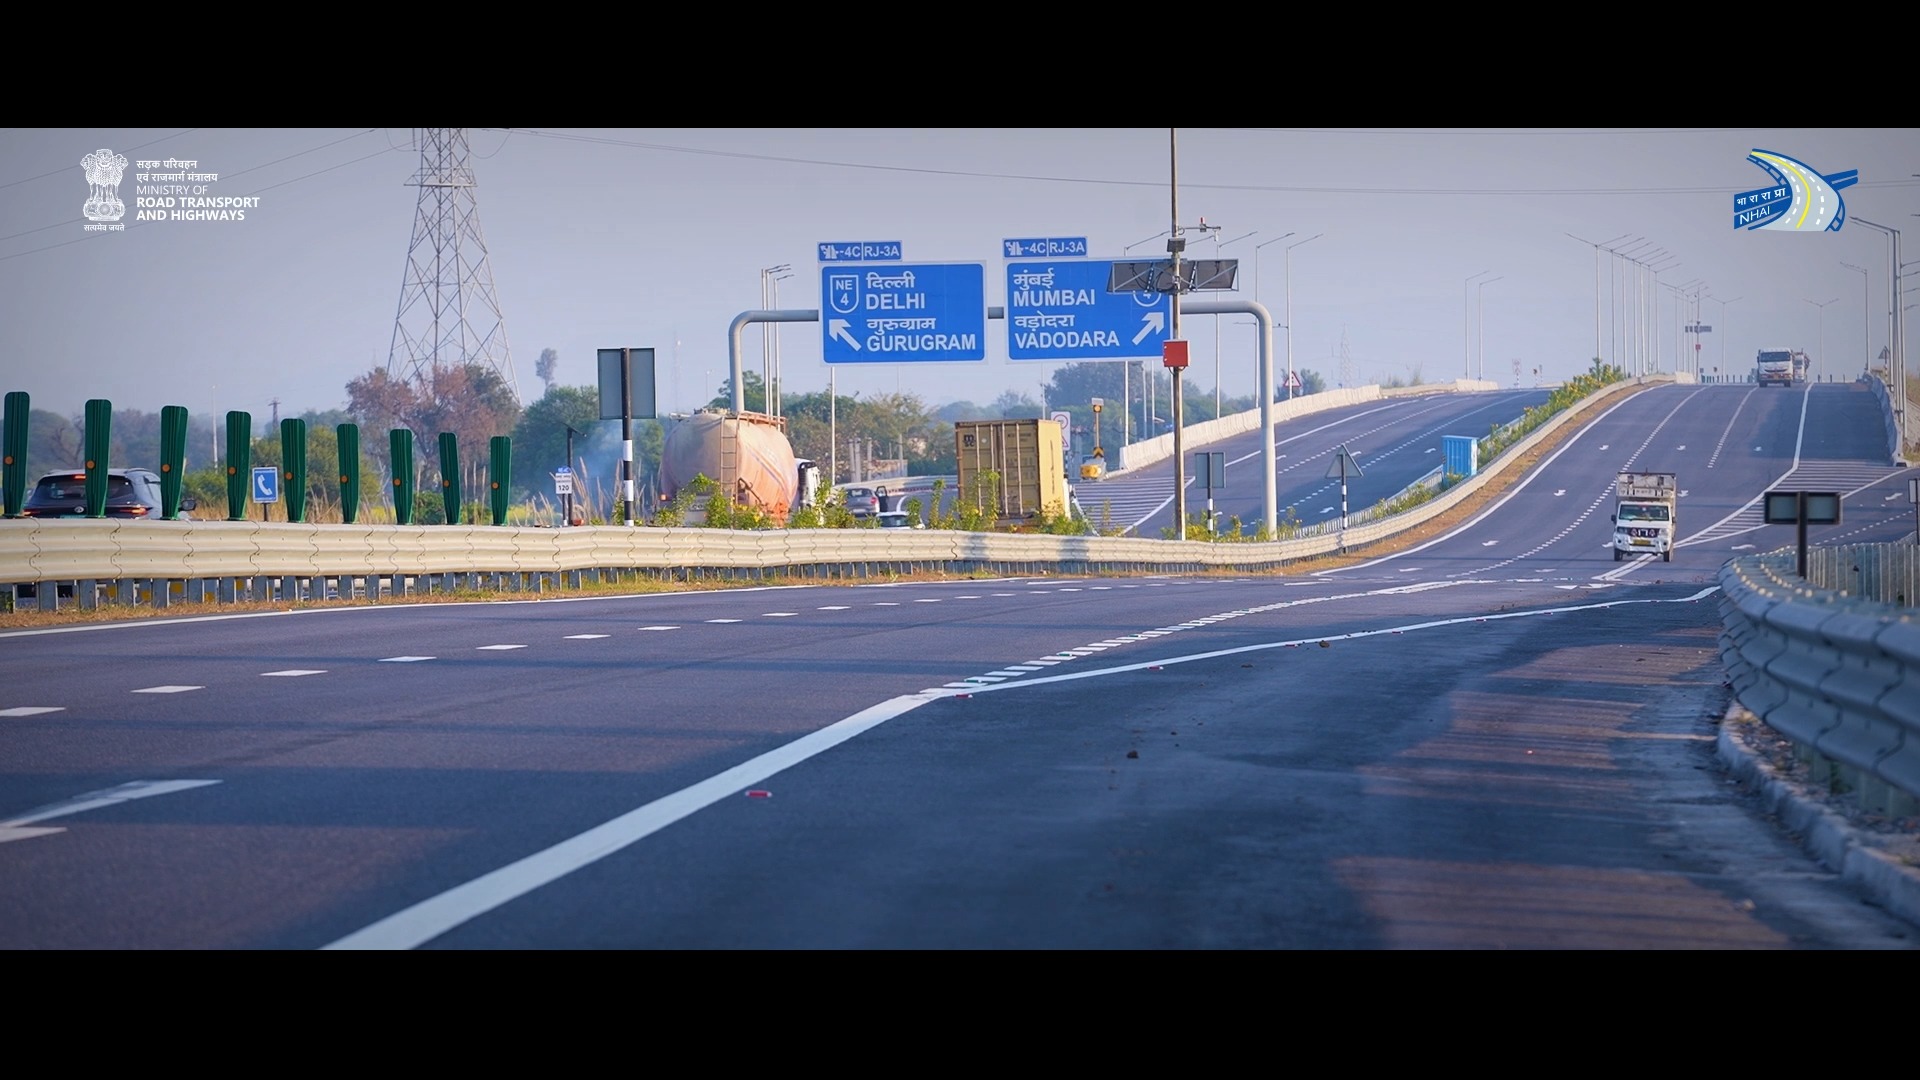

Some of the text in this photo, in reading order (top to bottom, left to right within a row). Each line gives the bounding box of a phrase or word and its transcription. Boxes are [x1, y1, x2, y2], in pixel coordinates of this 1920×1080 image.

[864, 246, 900, 257] RJ-3A
[1049, 239, 1085, 253] RJ-3A
[836, 280, 852, 290] NE
[866, 271, 916, 290] दिल्ली
[1014, 268, 1055, 290] मुंबई
[840, 294, 849, 306] 4
[866, 293, 926, 310] DELHI
[1014, 289, 1096, 307] MUMBAI
[866, 318, 936, 336] गुरुग्राम
[1014, 310, 1075, 332] वड़ोदरा
[866, 334, 976, 352] GURUGRAM
[1014, 330, 1120, 348] VADODARA
